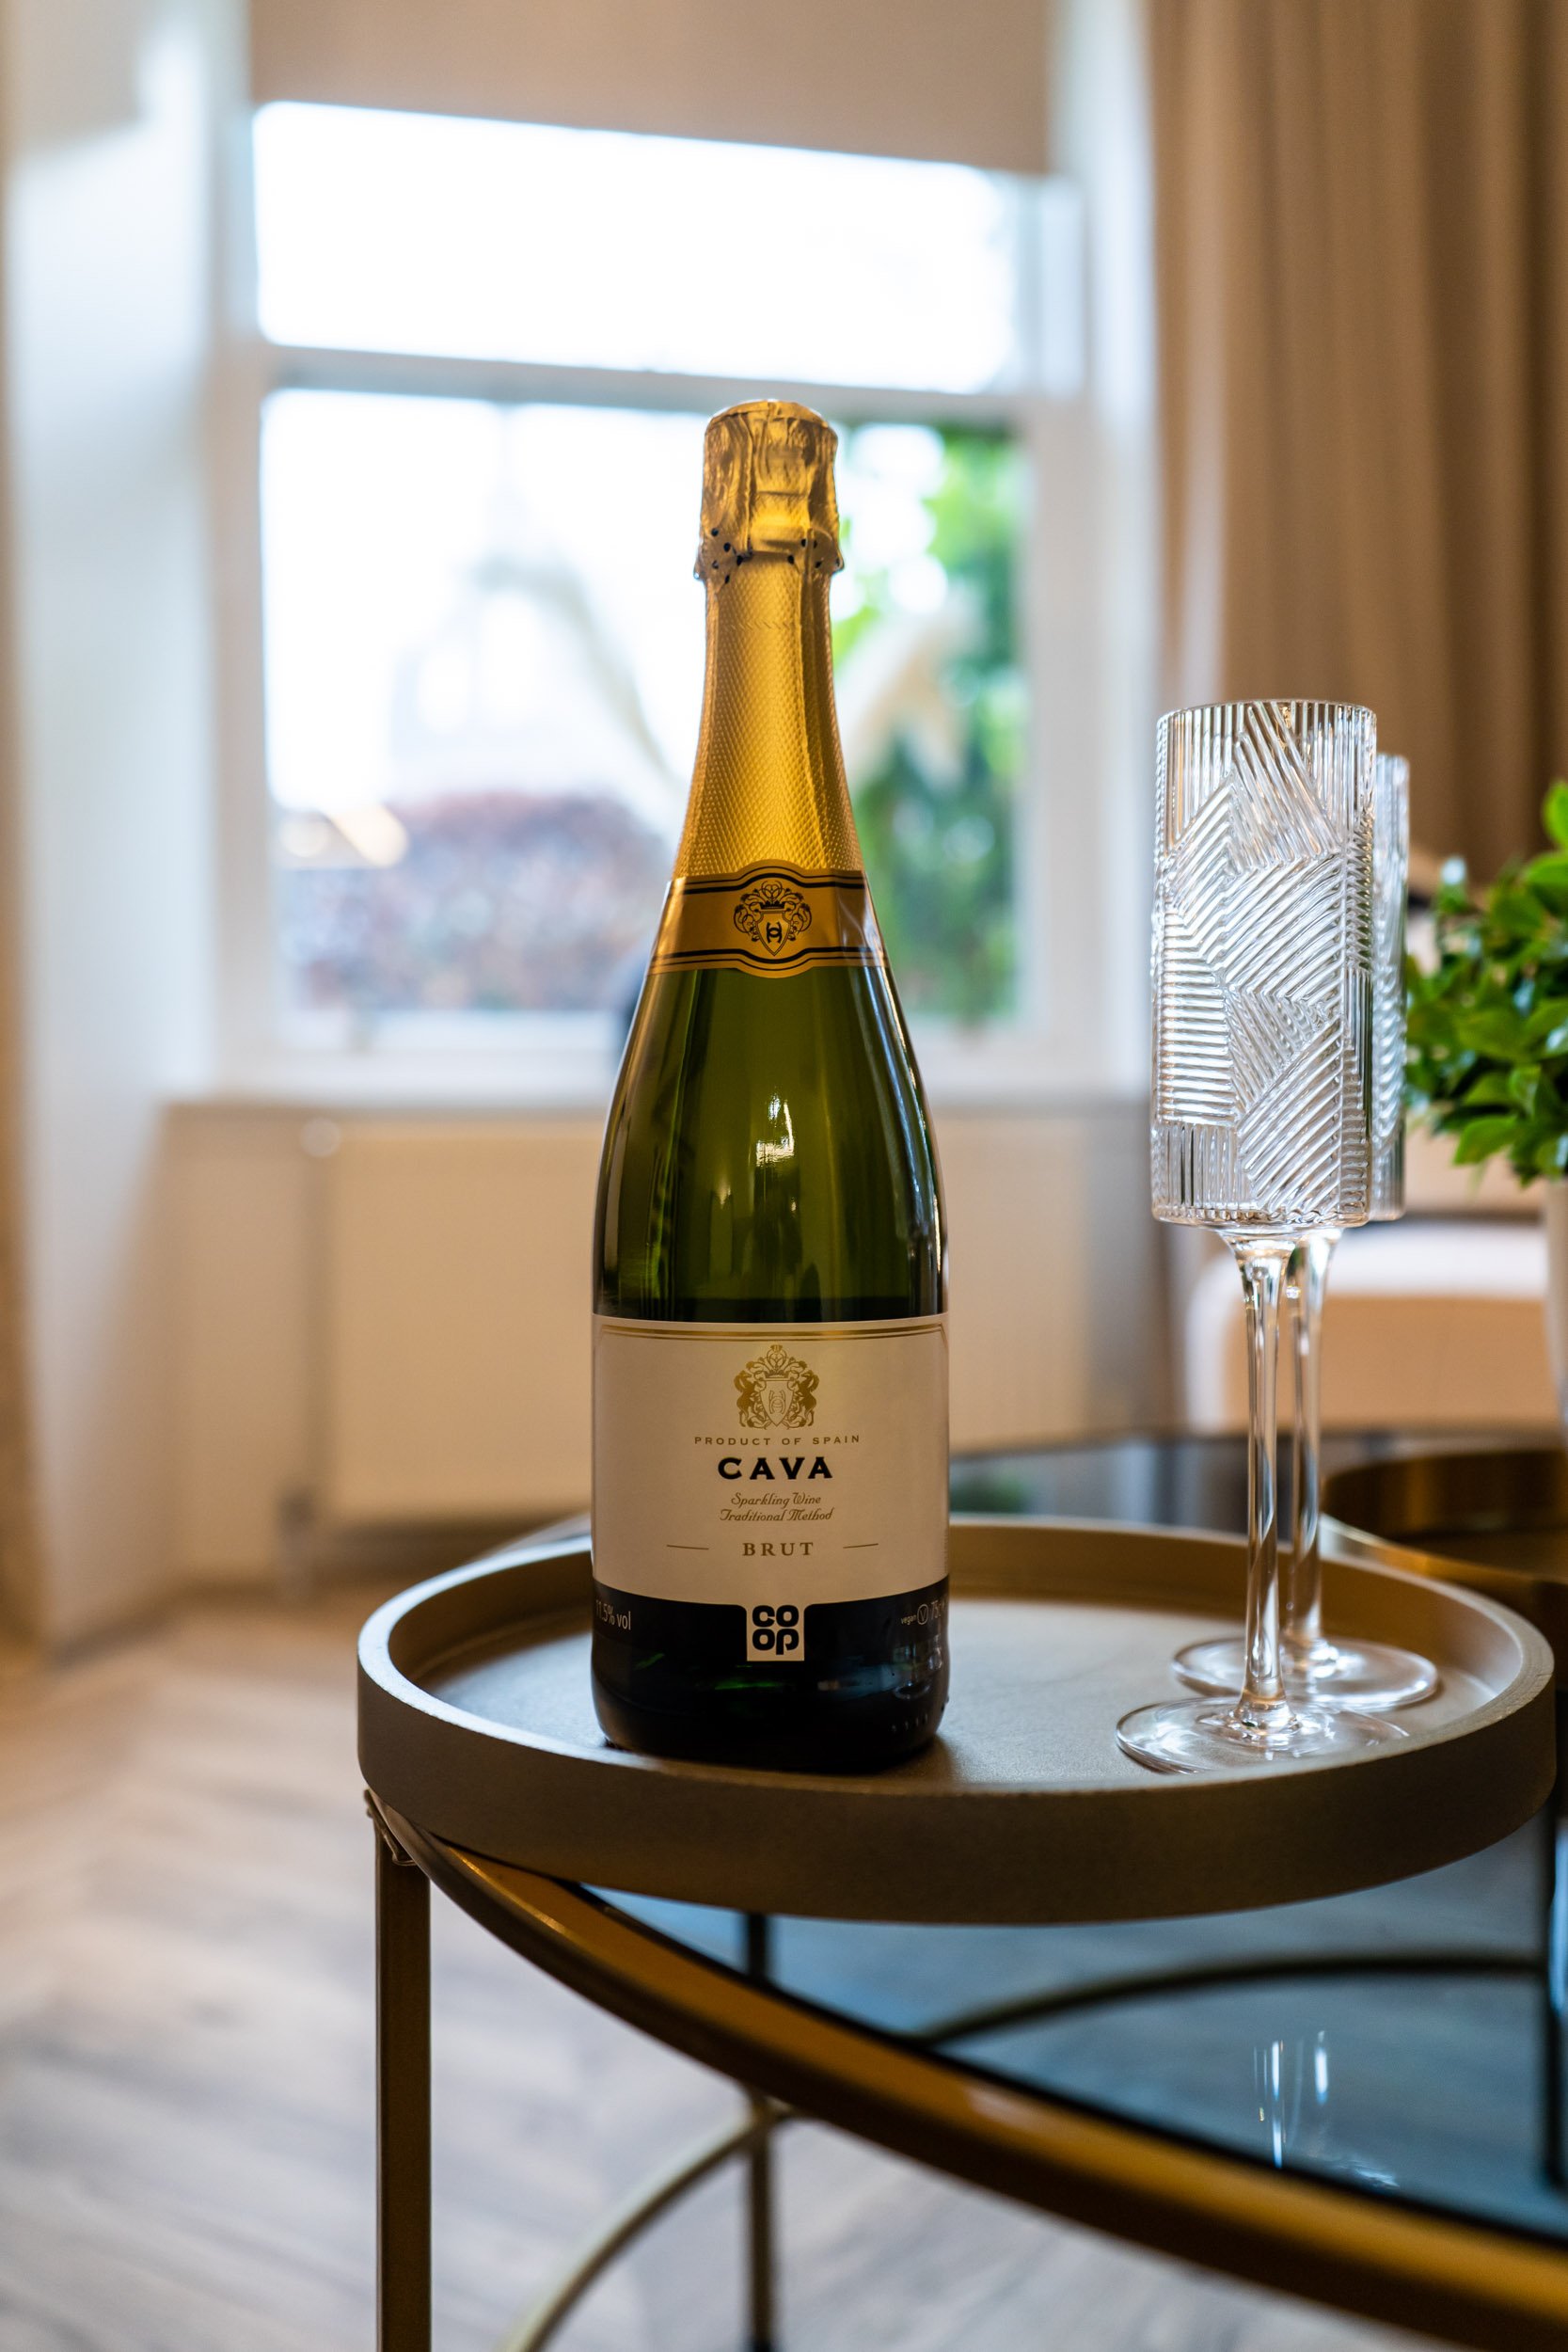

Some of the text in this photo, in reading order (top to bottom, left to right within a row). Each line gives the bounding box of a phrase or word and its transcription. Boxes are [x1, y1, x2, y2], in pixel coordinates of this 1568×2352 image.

[694, 1434, 861, 1447] PRODUCT OF SPAIN
[717, 1456, 833, 1481] CAVA
[731, 1491, 822, 1509] Sparkling Wine
[719, 1507, 834, 1522] Traditional Method
[742, 1542, 815, 1557] BRUT
[616, 1610, 632, 1631] vol
